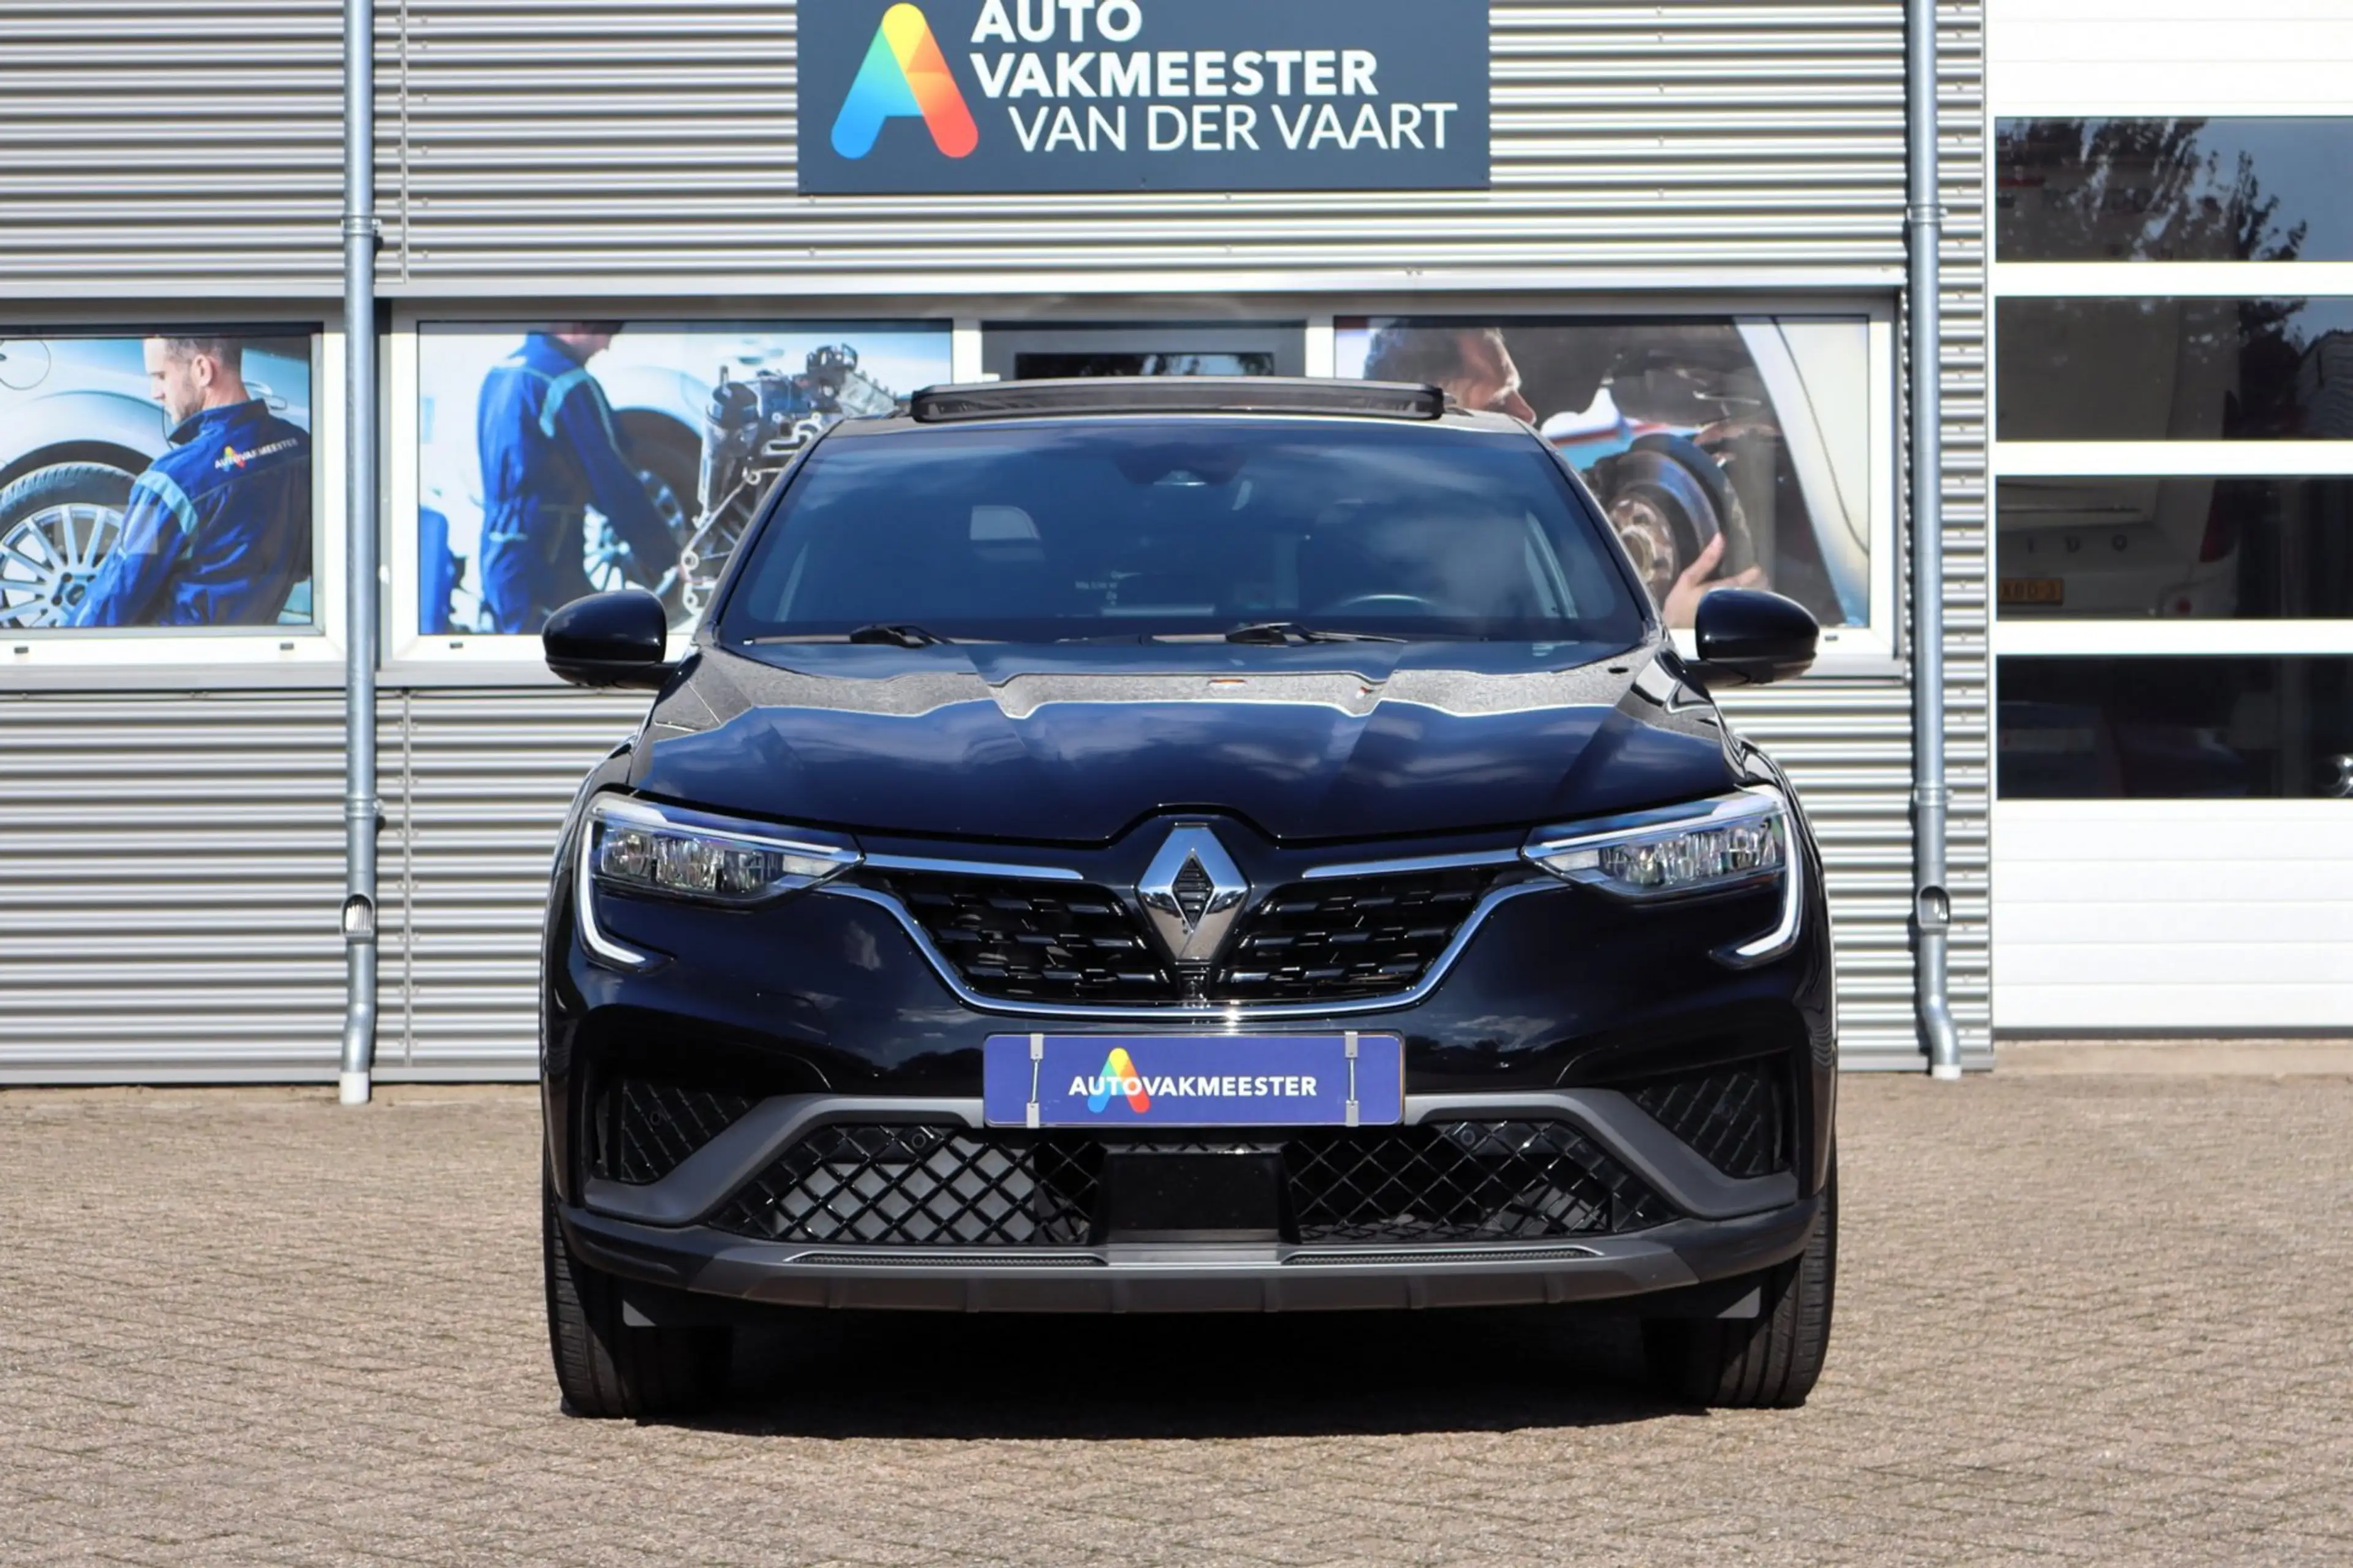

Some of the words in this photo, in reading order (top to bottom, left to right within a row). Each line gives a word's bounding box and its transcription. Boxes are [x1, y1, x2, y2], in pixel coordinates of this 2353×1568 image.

[971, 0, 1142, 42] AUTO
[969, 50, 1378, 97] VAKMEESTER
[1008, 105, 1126, 151] VAN
[1148, 105, 1259, 151] DER
[1271, 103, 1458, 150] VAART
[1069, 1076, 1317, 1096] AUTOVAKMEESTER
